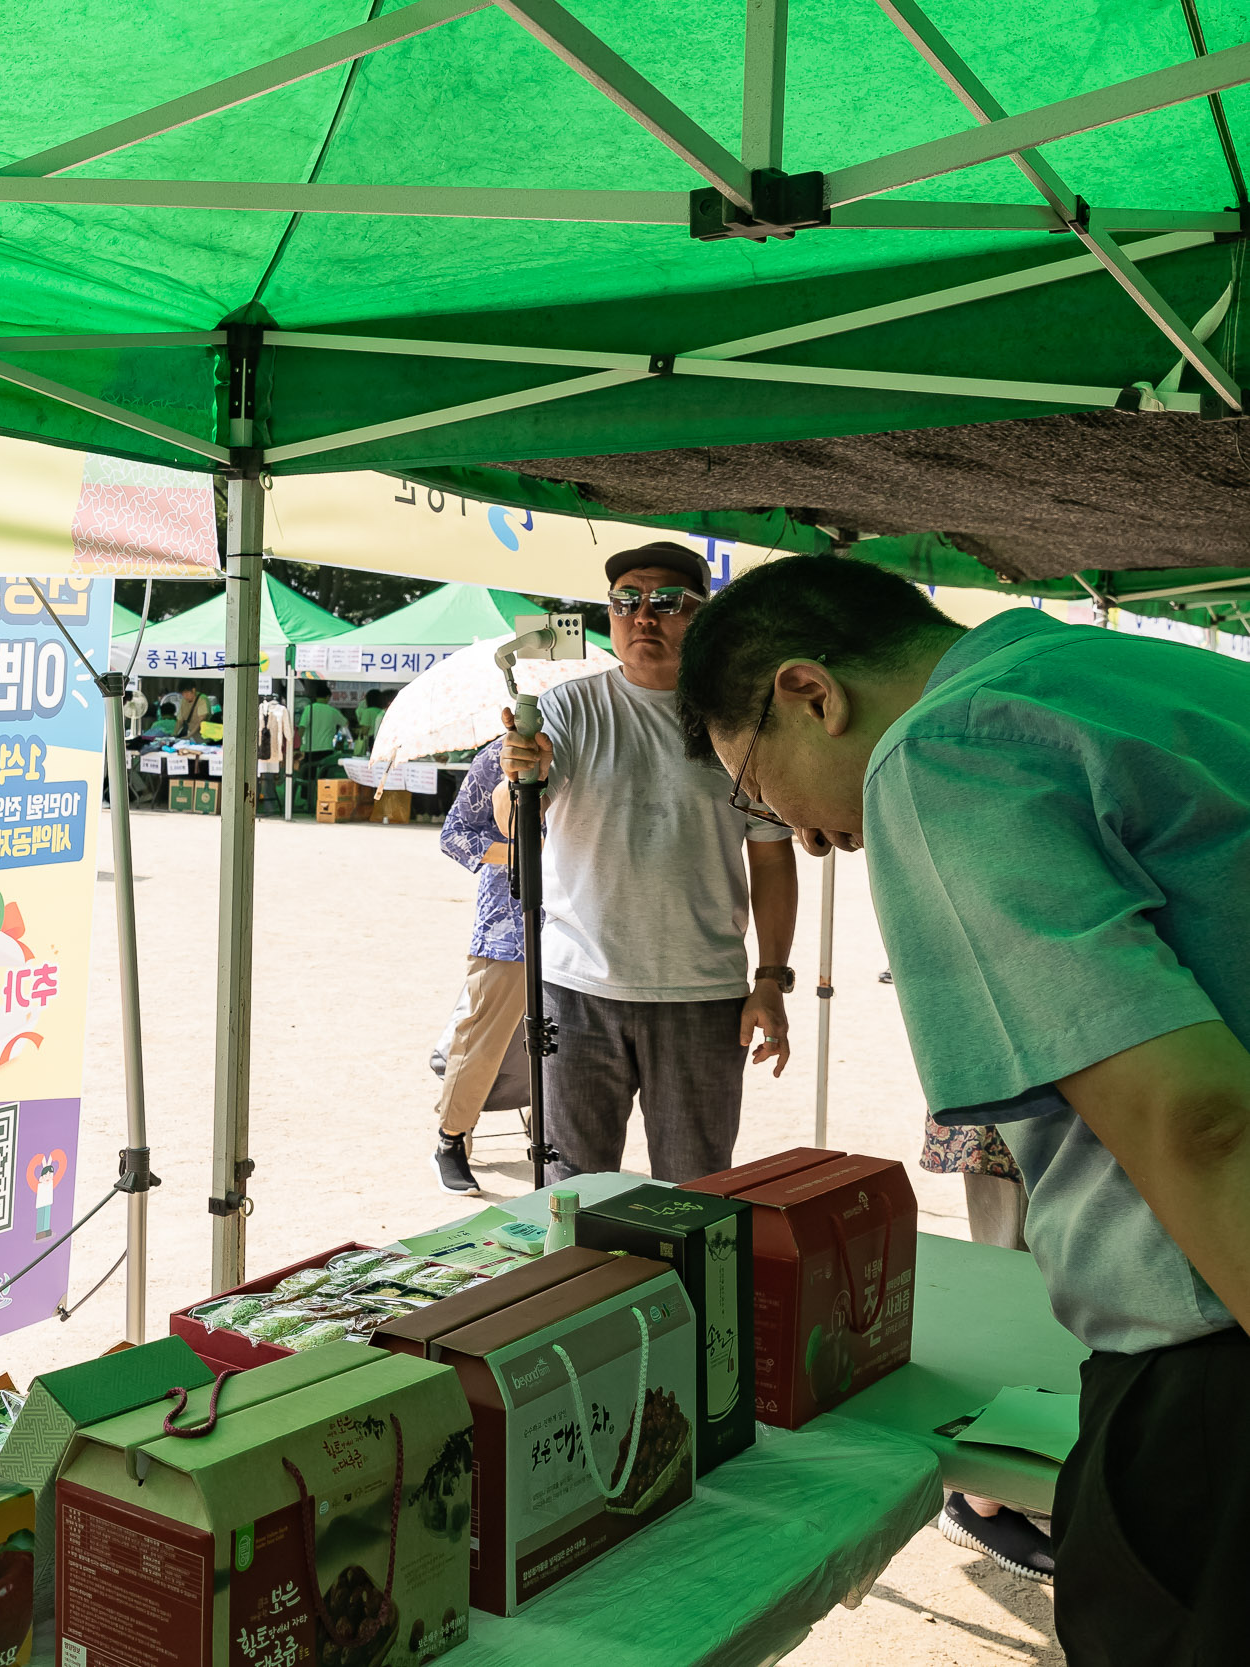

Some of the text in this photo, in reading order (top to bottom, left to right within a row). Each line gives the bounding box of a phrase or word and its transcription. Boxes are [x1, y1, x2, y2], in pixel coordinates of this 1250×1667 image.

[362, 653, 454, 673] 구의제2
[885, 1288, 910, 1319] 사과즙
[269, 1580, 301, 1614] 보은
